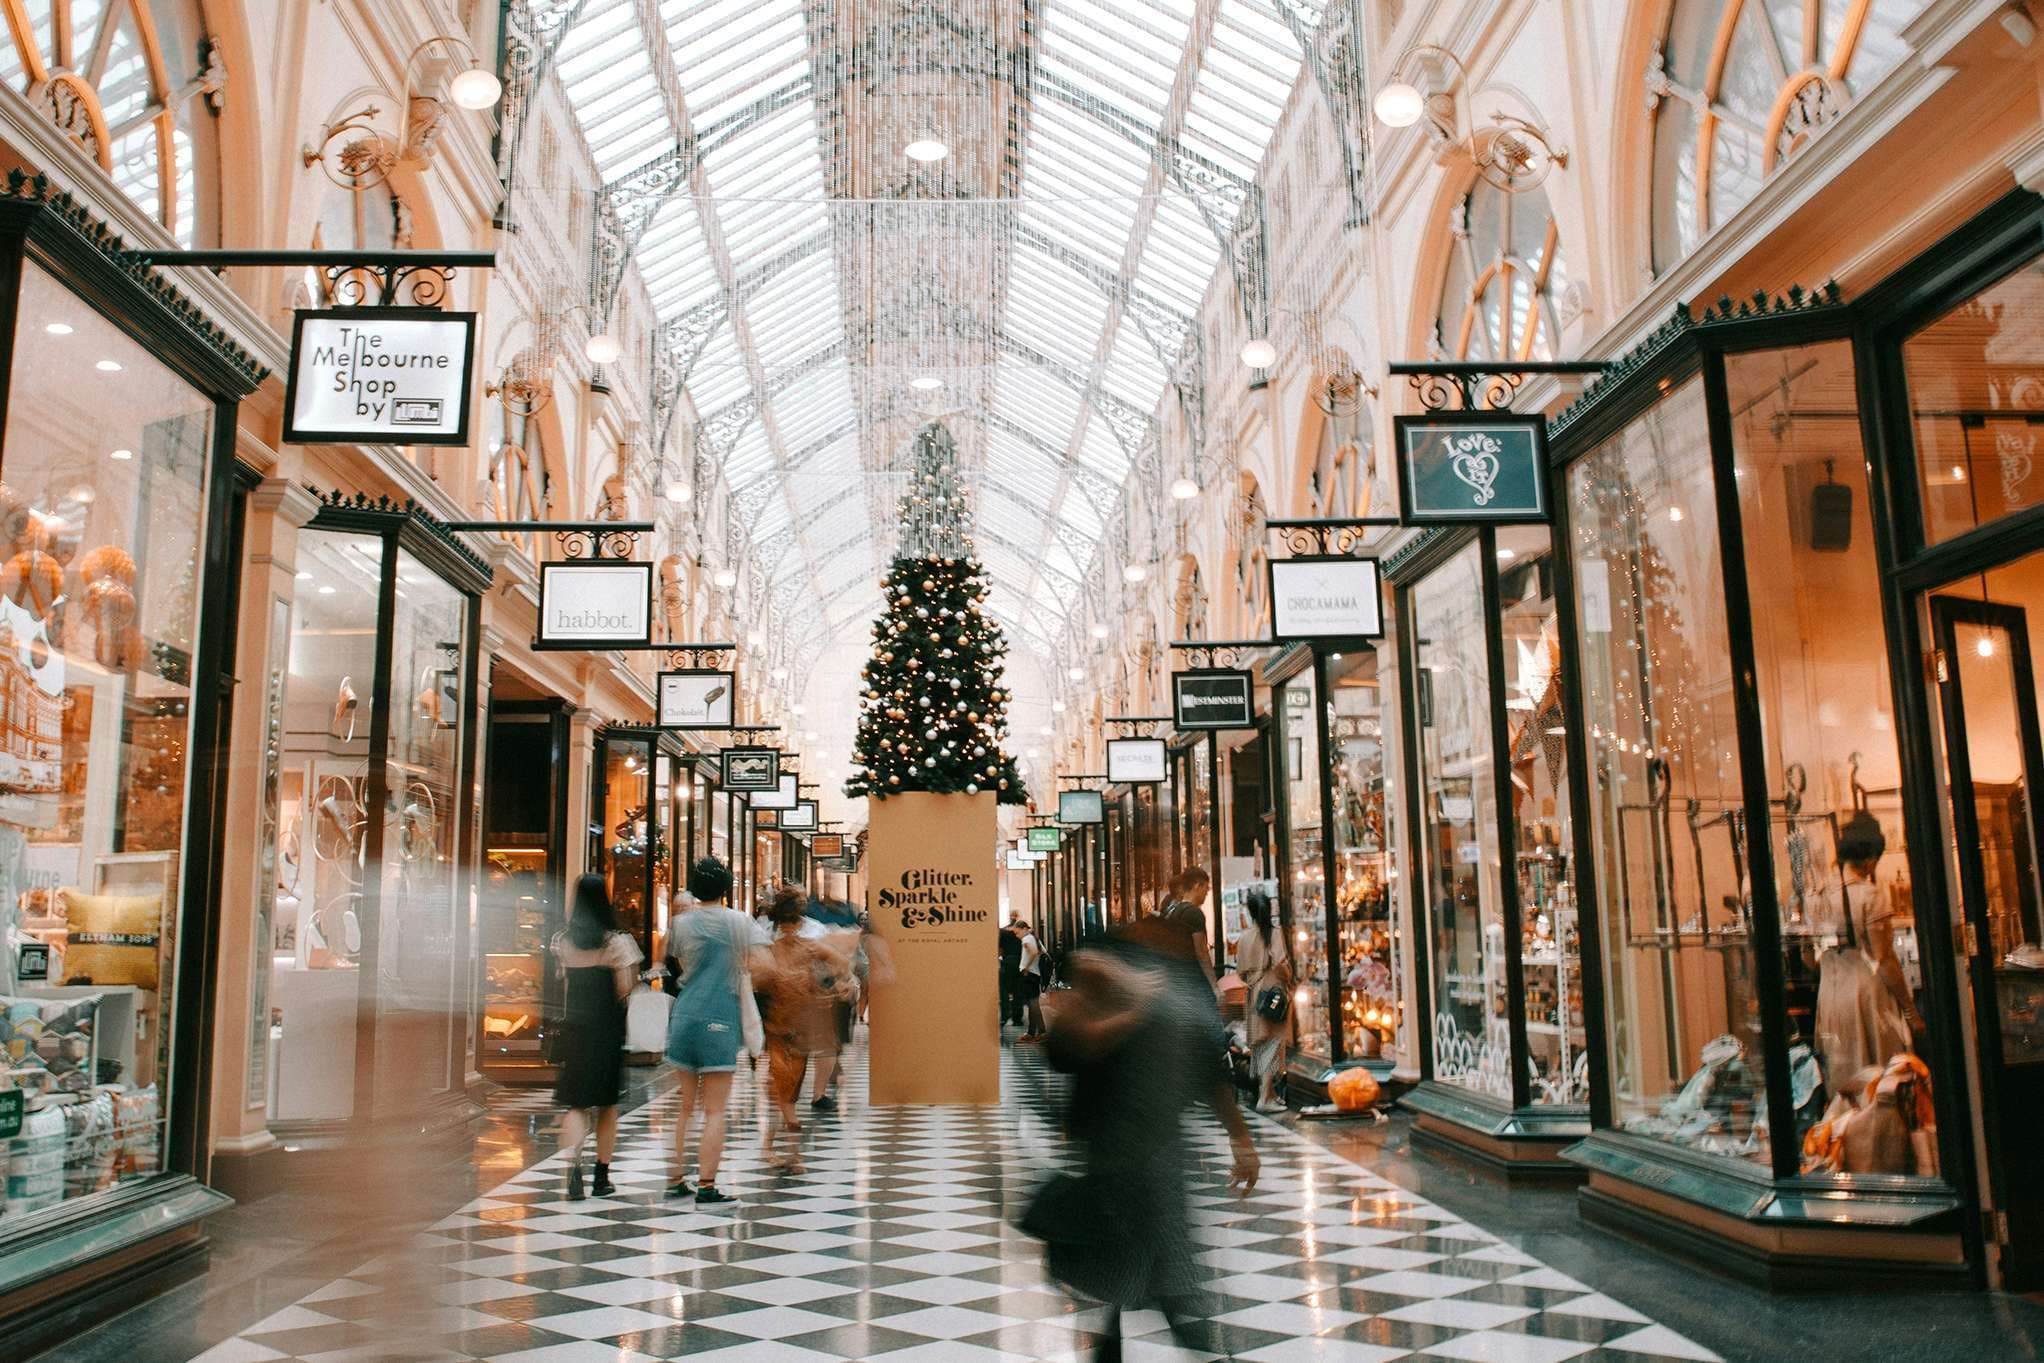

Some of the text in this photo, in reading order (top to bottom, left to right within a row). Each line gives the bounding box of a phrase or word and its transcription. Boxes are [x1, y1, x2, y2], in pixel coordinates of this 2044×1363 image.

[340, 328, 383, 348] The
[312, 346, 449, 369] Melbourne
[333, 371, 397, 399] Shop
[356, 400, 386, 421] by
[1287, 597, 1359, 611] CHOCAMAMA
[878, 887, 957, 909] Sparkle
